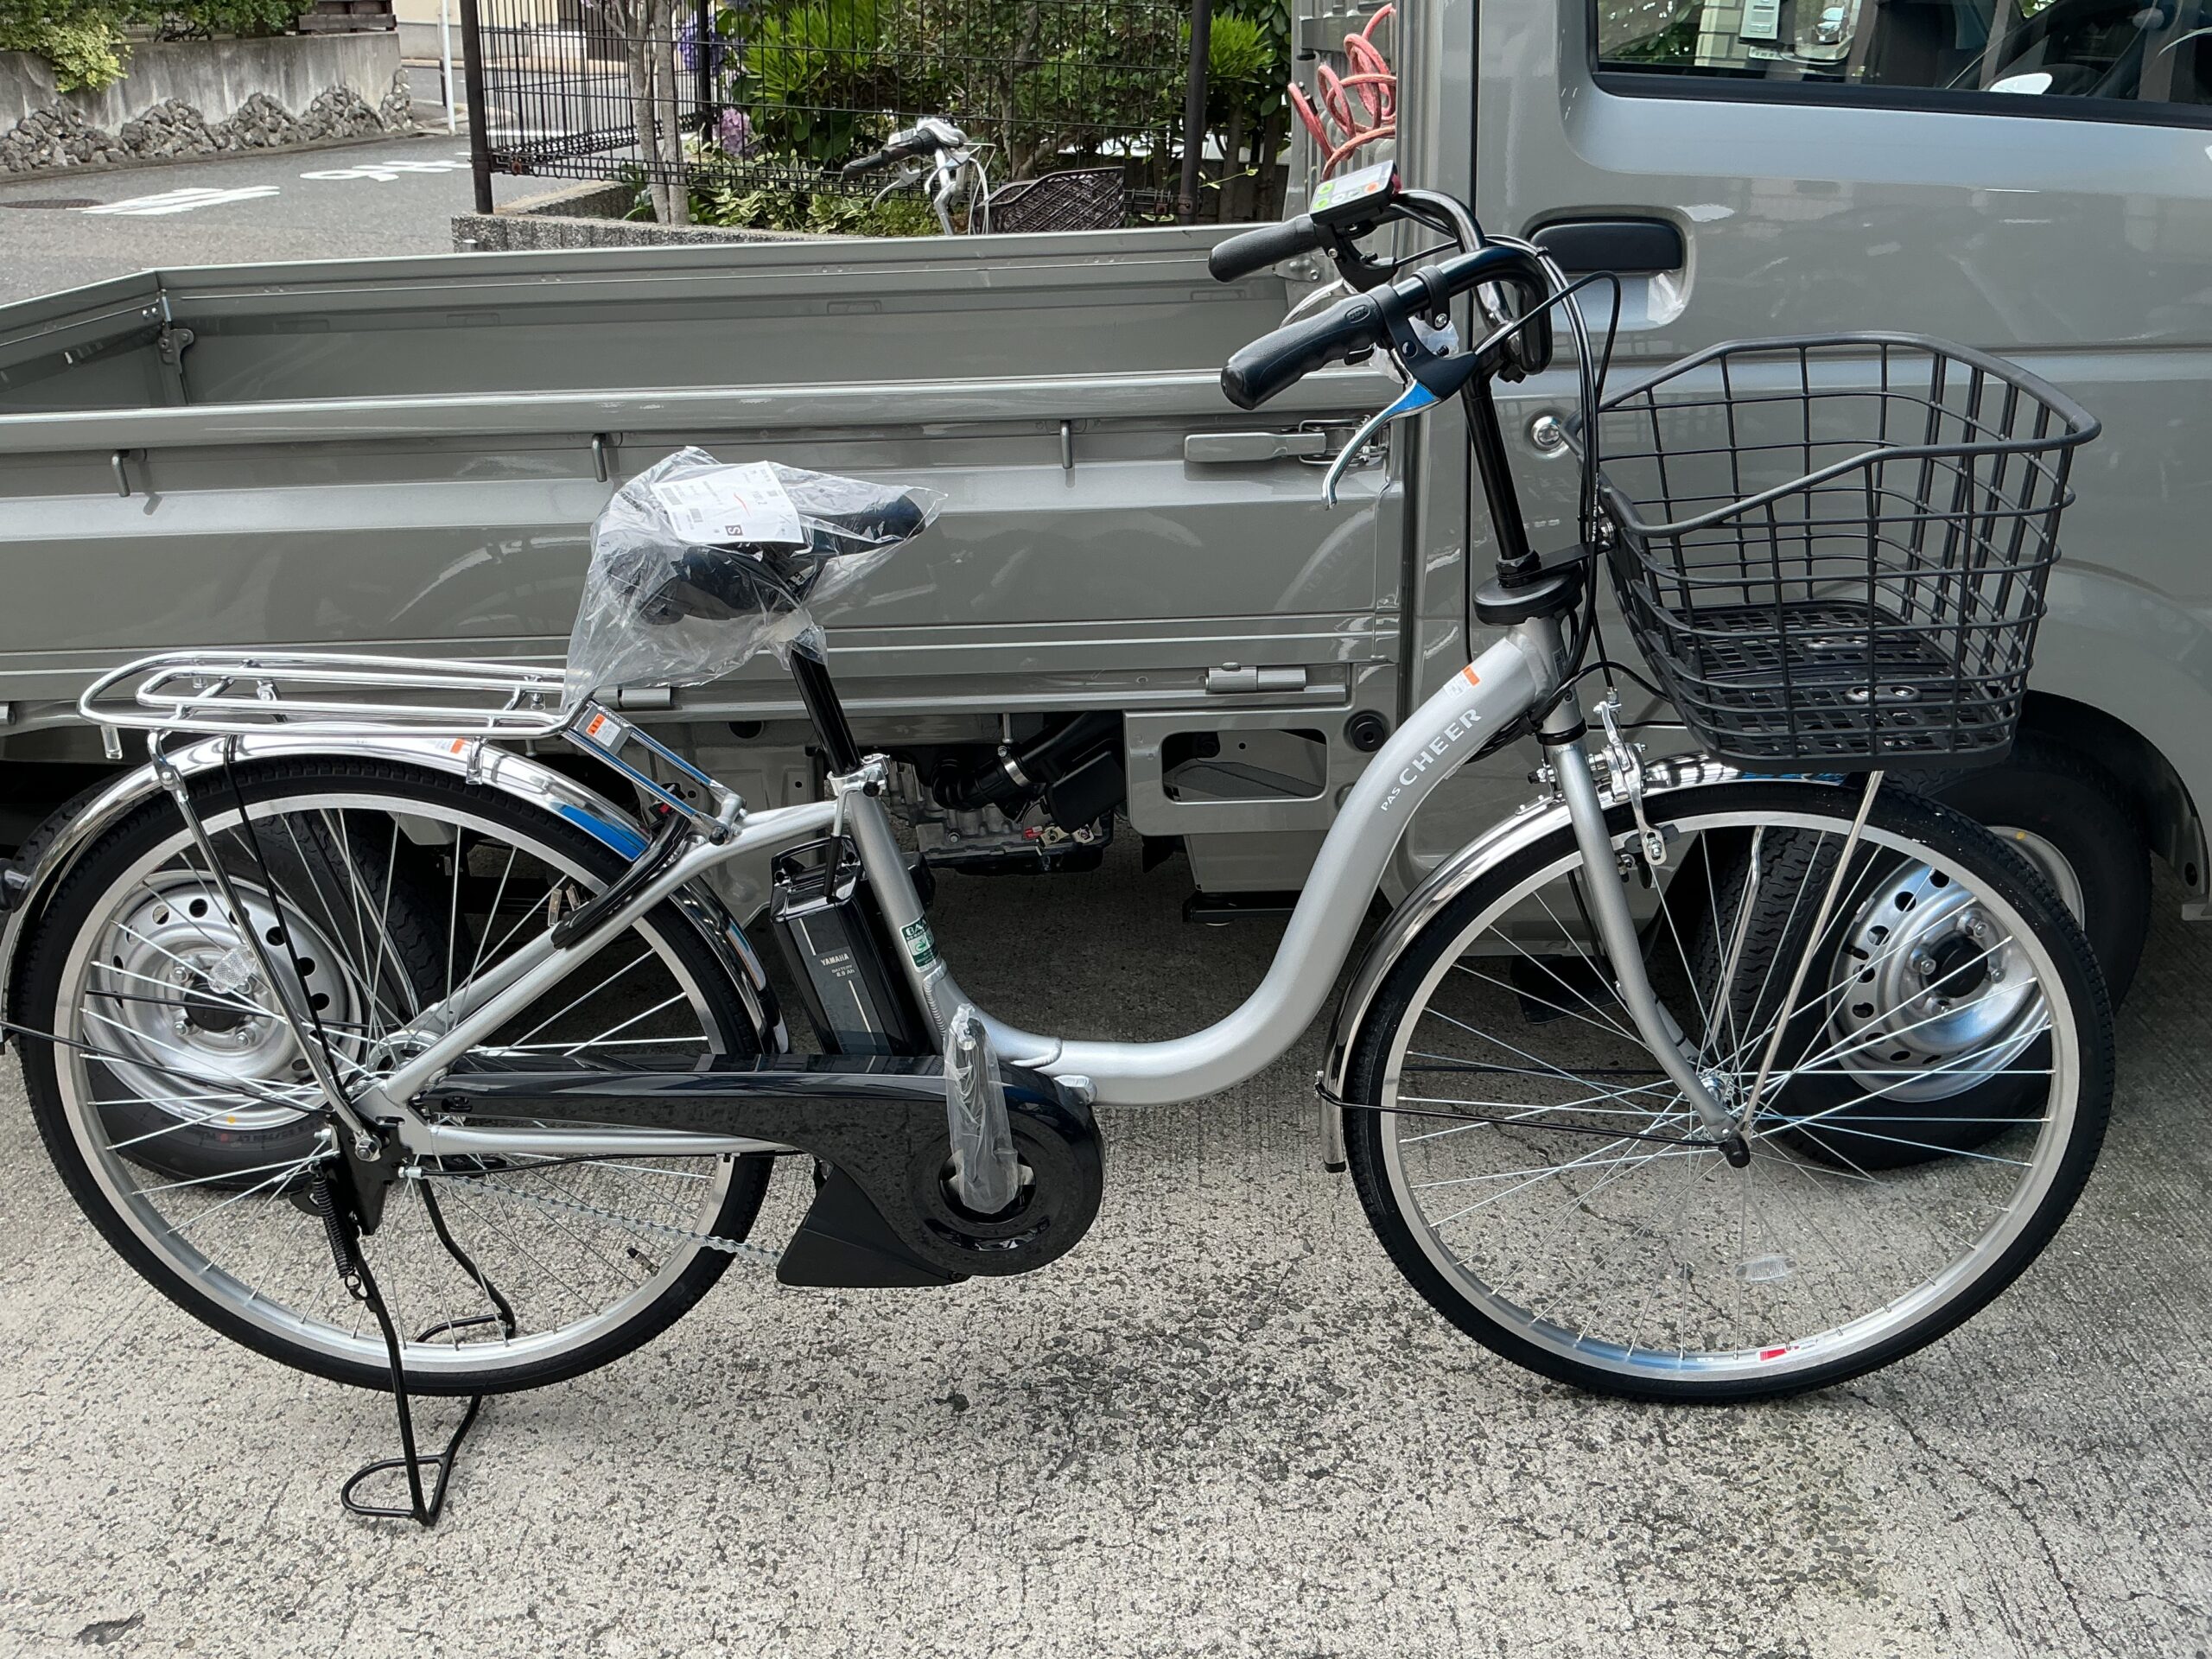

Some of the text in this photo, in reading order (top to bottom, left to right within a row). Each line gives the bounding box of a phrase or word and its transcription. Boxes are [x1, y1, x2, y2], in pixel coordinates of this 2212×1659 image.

[1380, 786, 1401, 812] PAS
[1399, 708, 1482, 786] CHEER
[820, 953, 849, 966] YAMAHA
